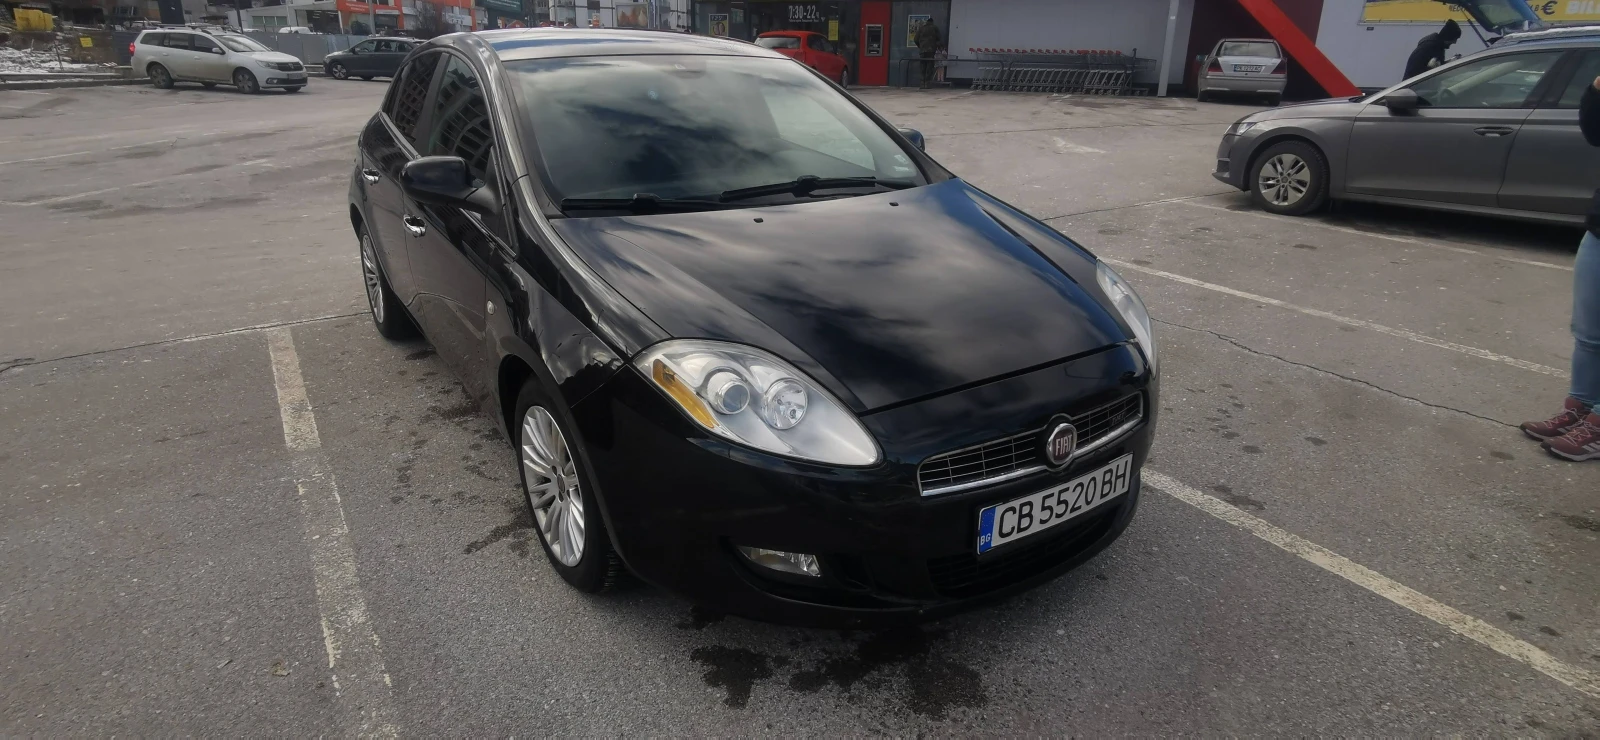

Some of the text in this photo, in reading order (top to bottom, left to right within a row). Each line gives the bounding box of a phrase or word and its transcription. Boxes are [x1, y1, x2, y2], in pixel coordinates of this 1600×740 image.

[1055, 433, 1073, 456] FIAT
[998, 460, 1129, 539] CB 5520 BH
[980, 533, 991, 546] BG
